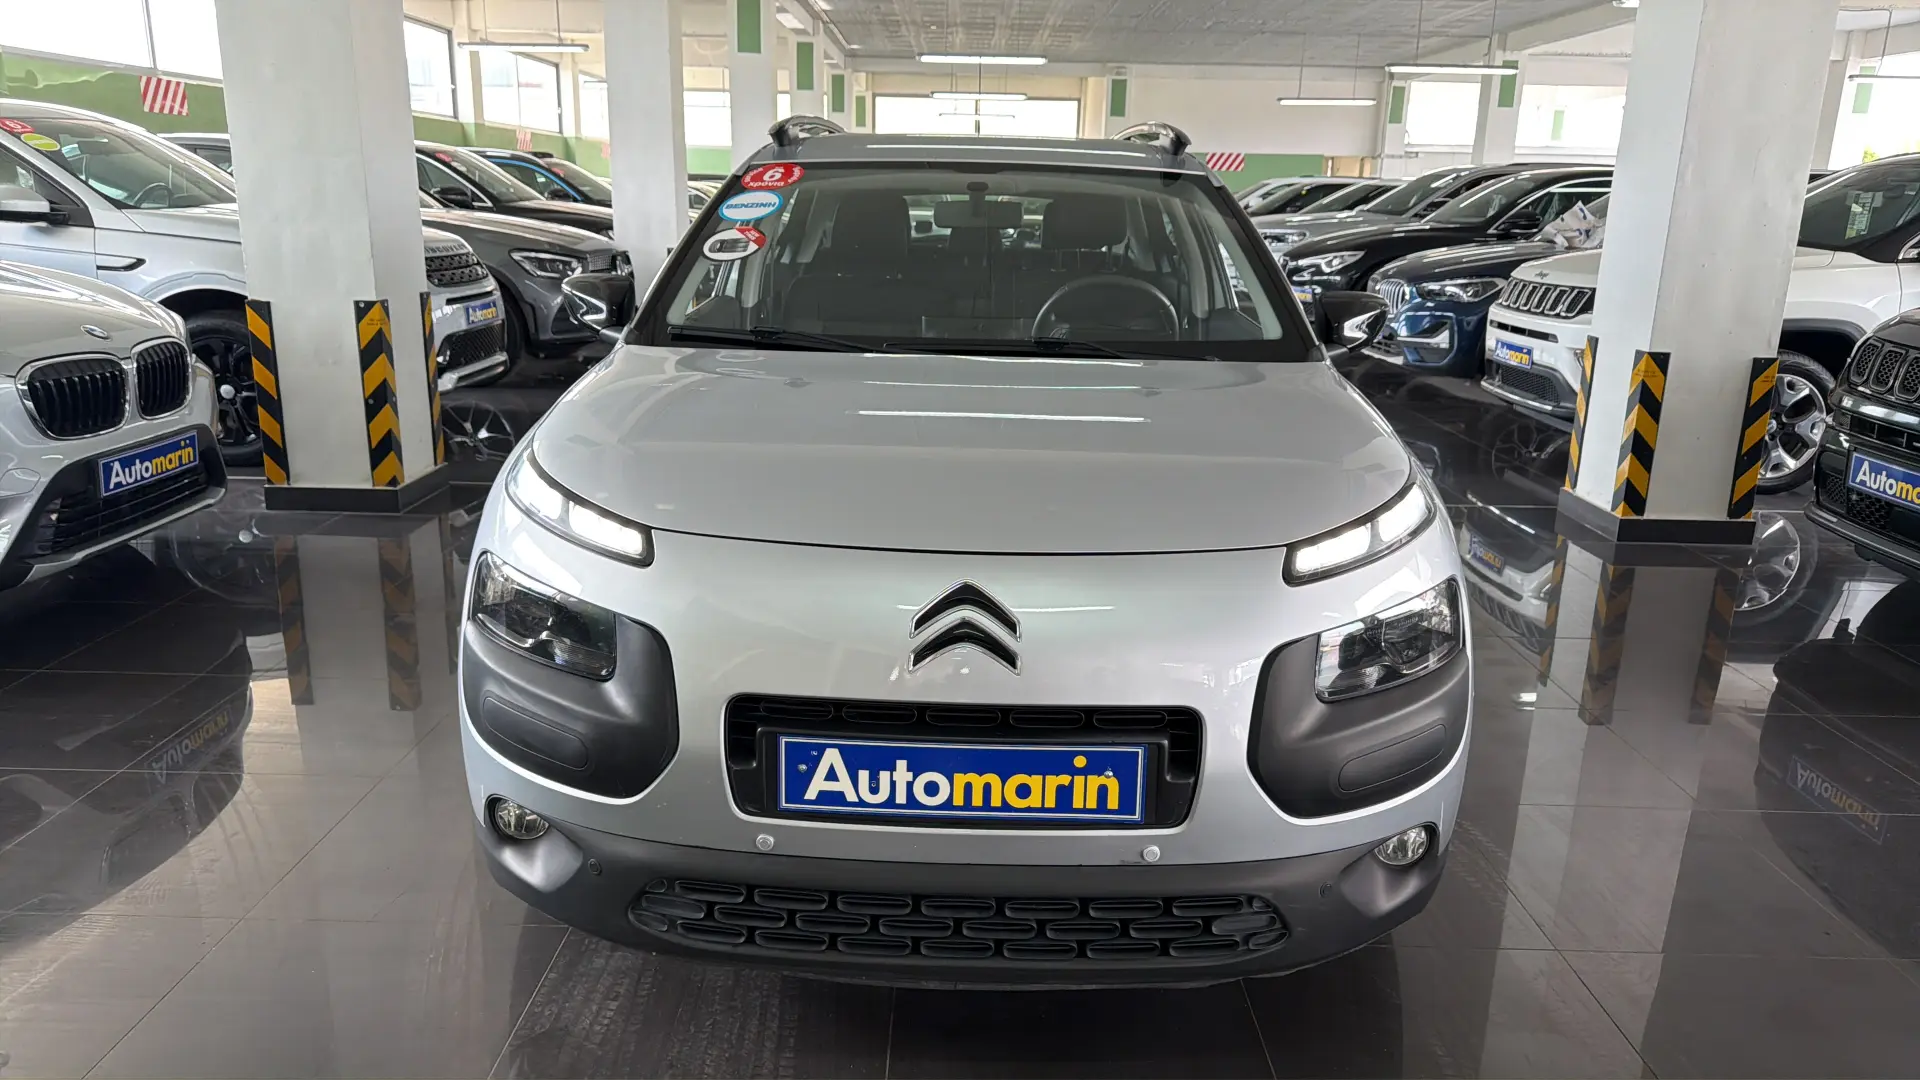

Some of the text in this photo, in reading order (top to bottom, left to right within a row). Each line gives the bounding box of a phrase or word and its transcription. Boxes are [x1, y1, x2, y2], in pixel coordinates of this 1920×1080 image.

[763, 167, 784, 181] 6
[109, 440, 194, 490] Automarin
[803, 747, 1119, 810] Automarin
